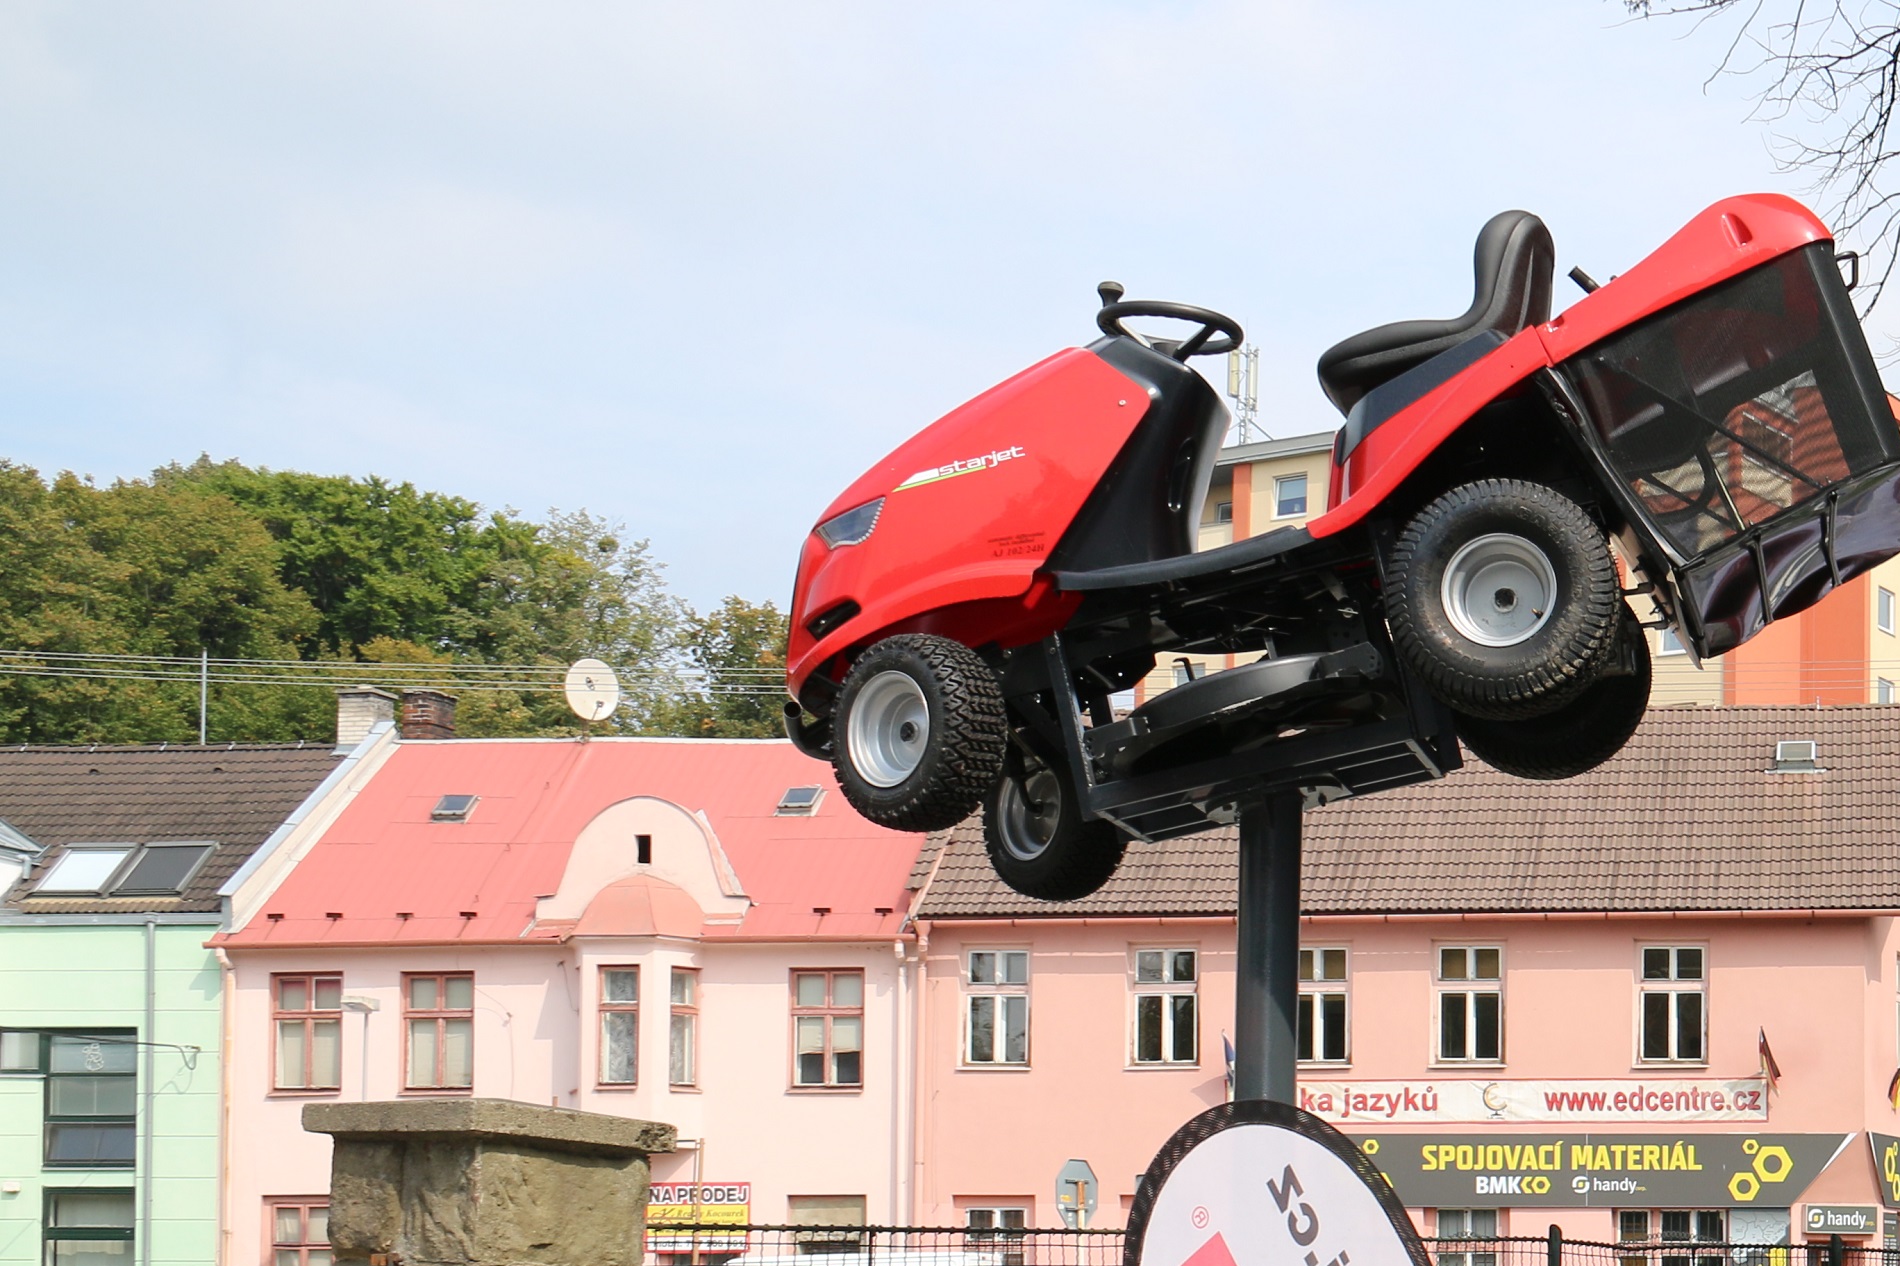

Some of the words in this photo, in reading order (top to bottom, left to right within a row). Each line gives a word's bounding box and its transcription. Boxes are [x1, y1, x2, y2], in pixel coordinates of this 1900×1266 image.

[938, 446, 1025, 477] starjet
[1301, 1087, 1333, 1112] ka
[1343, 1086, 1438, 1118] jazyků
[1544, 1086, 1761, 1112] www.edcentre.cz
[1421, 1140, 1562, 1171] SPOJOVACÍ
[1570, 1140, 1703, 1171] MATERIÁL
[650, 1188, 673, 1203] NA
[677, 1187, 747, 1203] PRODEJ
[1593, 1177, 1637, 1194] handy
[1827, 1210, 1867, 1229] handy
